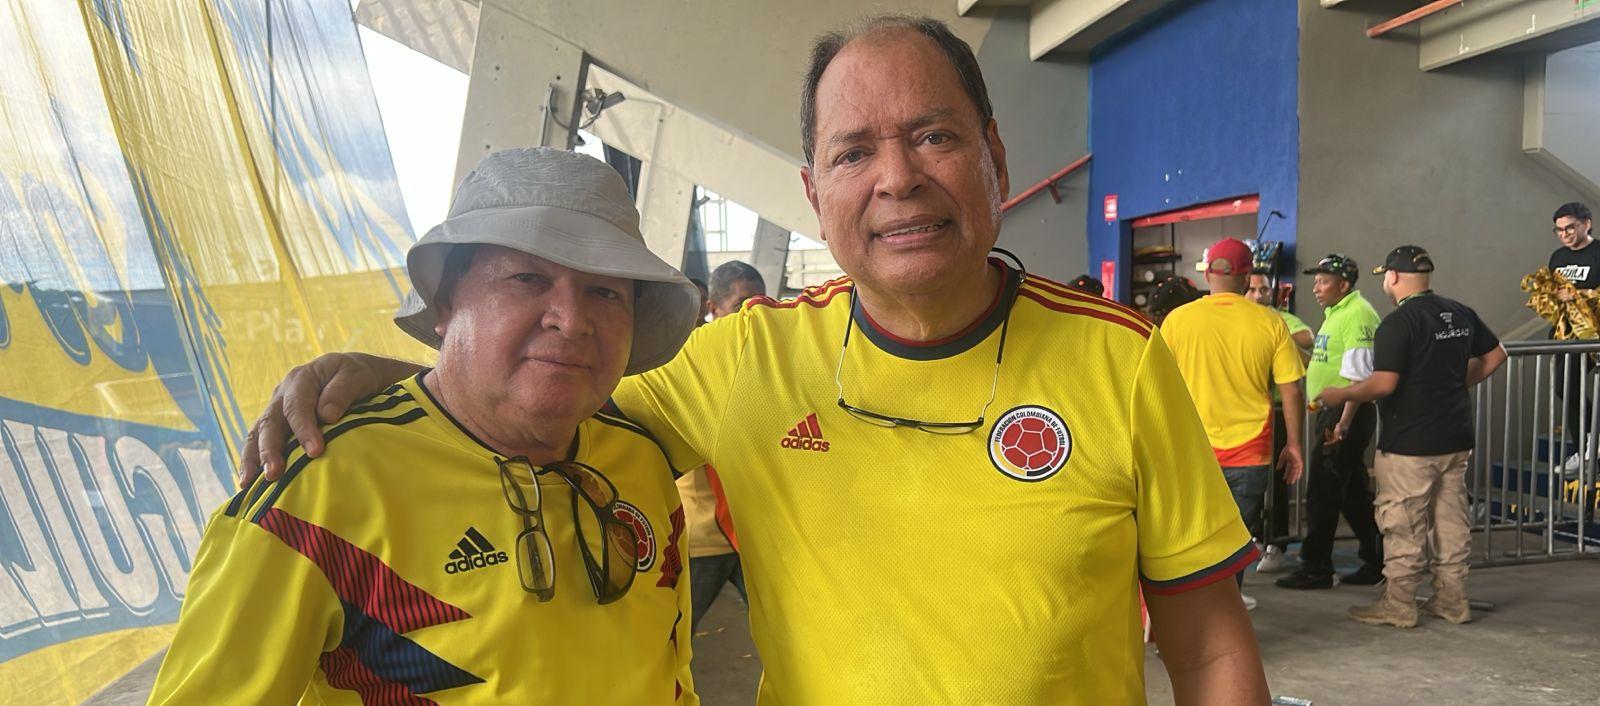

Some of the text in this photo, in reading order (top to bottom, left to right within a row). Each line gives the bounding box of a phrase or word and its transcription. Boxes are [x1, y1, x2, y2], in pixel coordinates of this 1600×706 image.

[1016, 411, 1053, 422] COLOMBIANA
[780, 435, 831, 452] adidas
[444, 551, 509, 575] adidas
